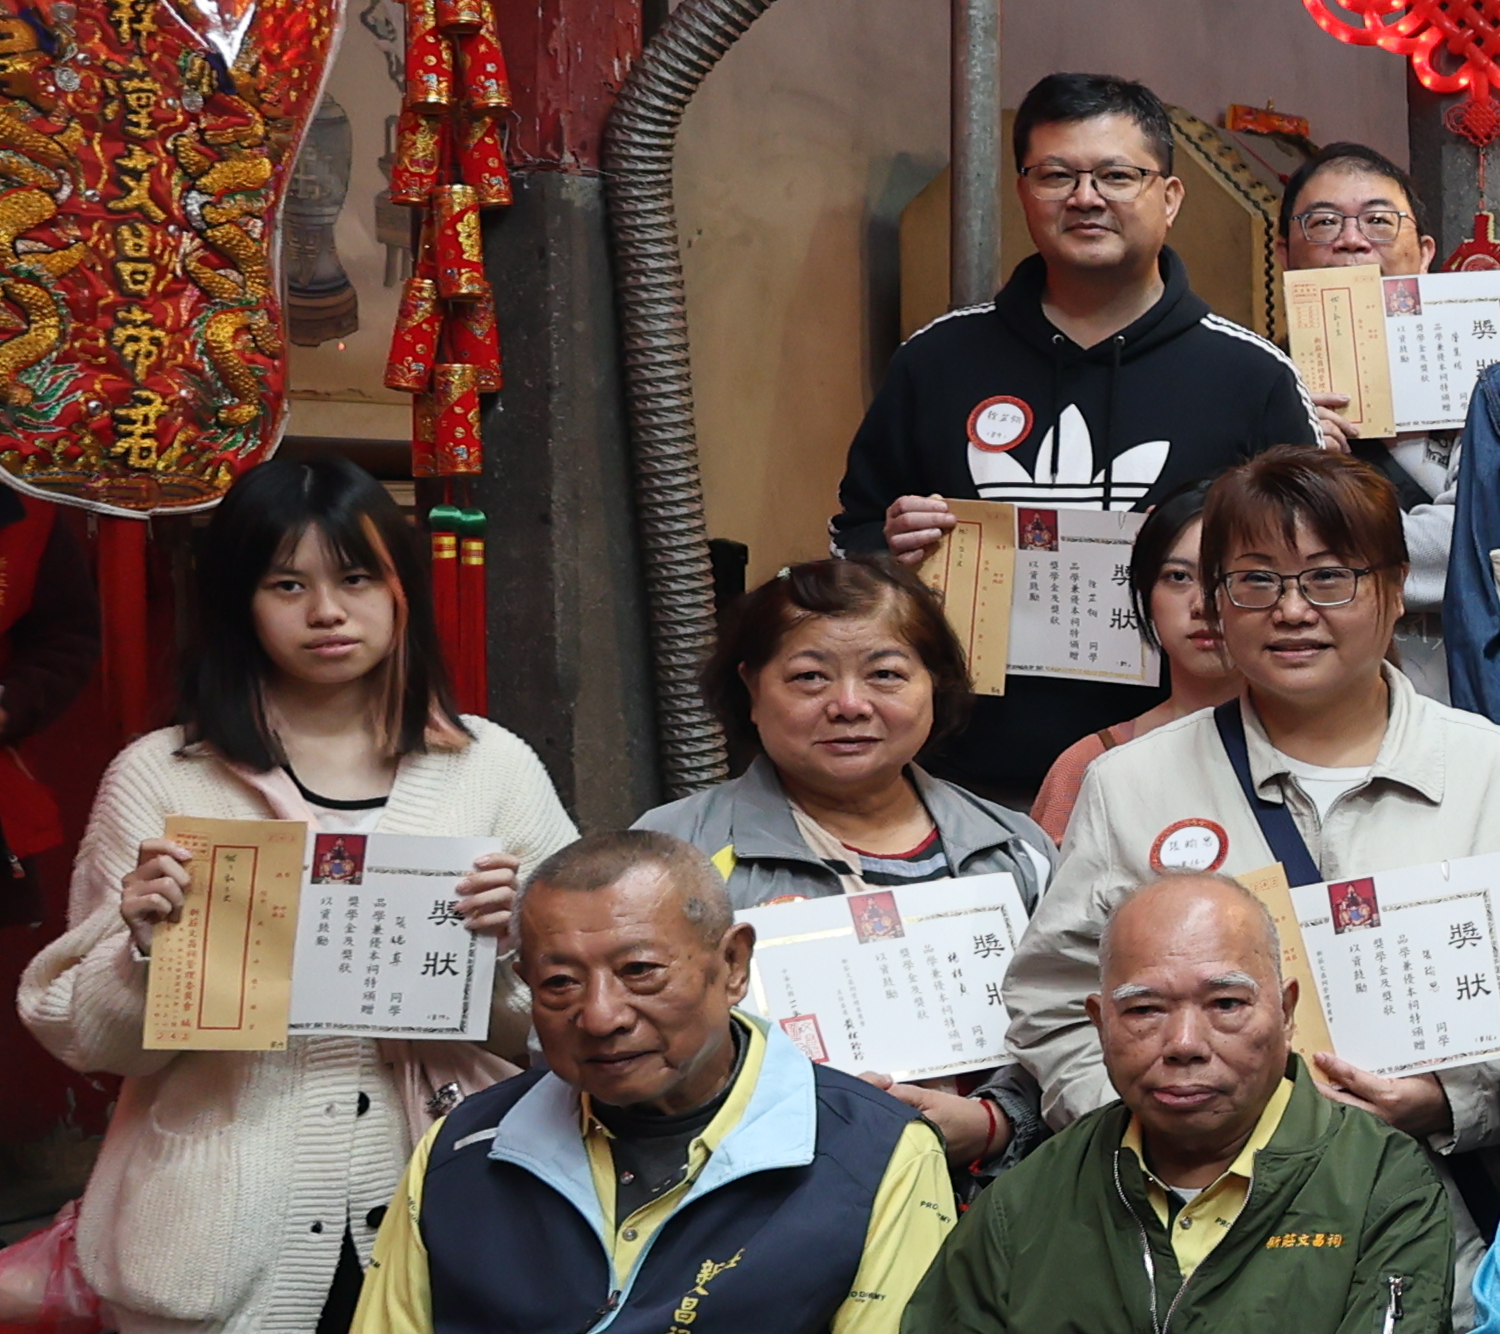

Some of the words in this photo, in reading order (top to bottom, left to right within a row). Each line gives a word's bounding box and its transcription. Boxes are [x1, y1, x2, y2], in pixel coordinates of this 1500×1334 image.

[338, 896, 360, 974] 獎學金及獎狀
[360, 898, 387, 1016] 品學兼優本祠特頒贈
[420, 899, 466, 978] 獎狀
[1349, 943, 1368, 994] 以資鼓勵
[1448, 921, 1492, 1001] 獎狀
[1373, 937, 1396, 1016] 獎學金及獎狀
[1396, 934, 1426, 1051] 品學兼優本祠特頒贈
[1436, 1021, 1450, 1047] 同學
[1265, 1233, 1345, 1248] 新莊文昌祠
